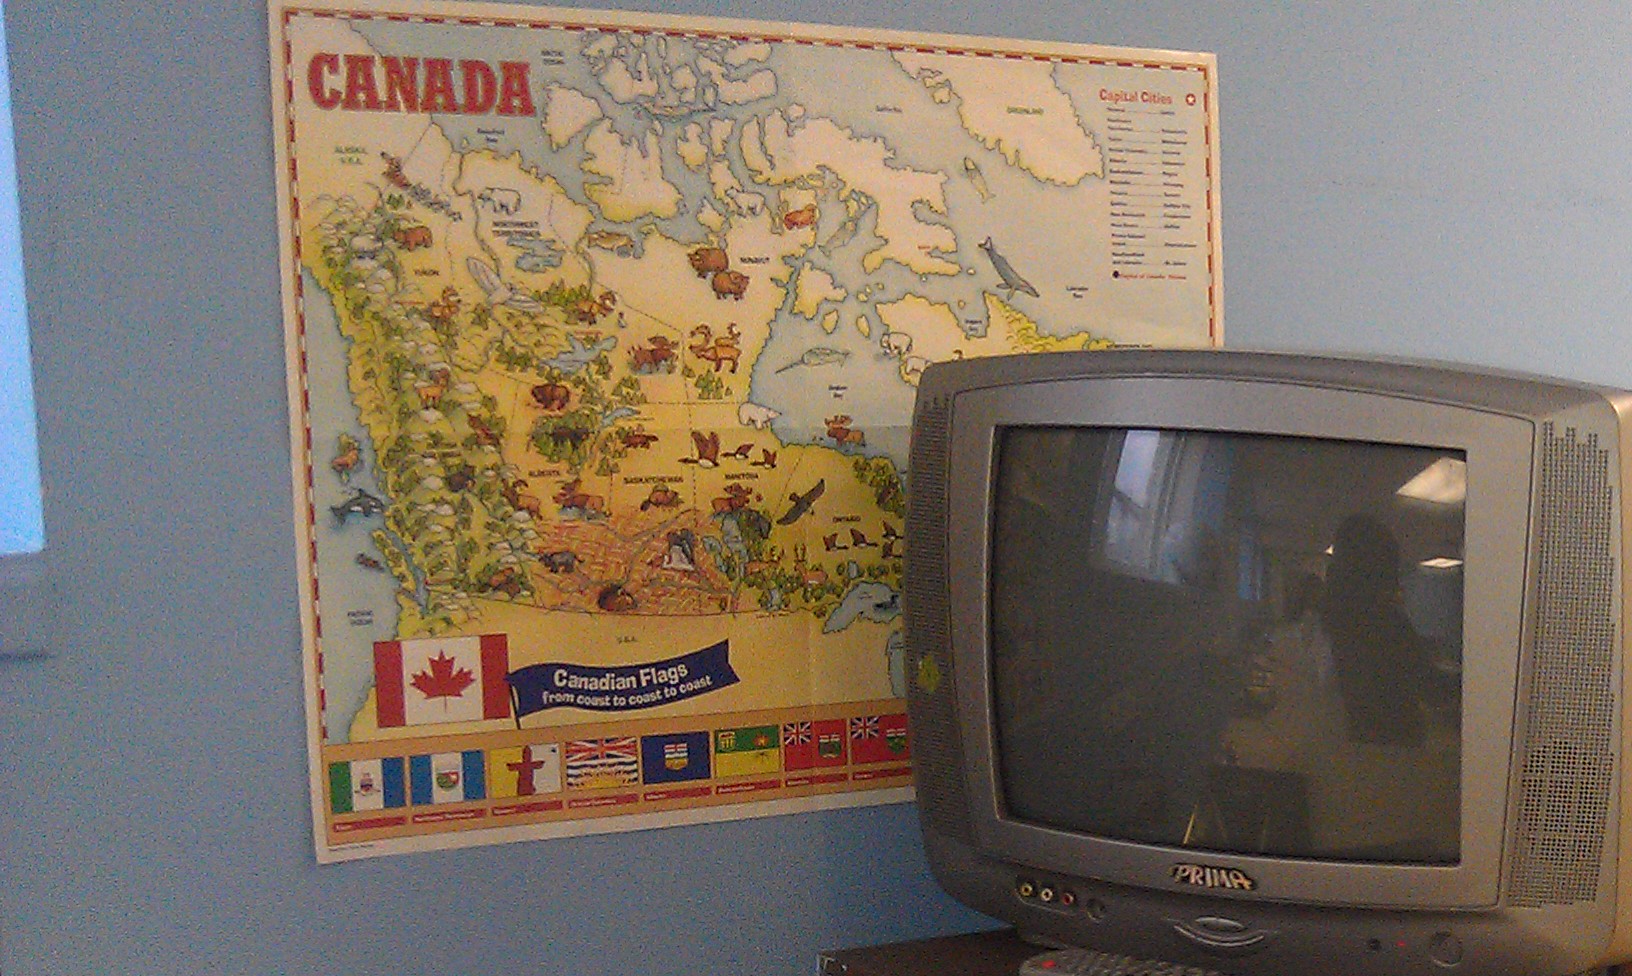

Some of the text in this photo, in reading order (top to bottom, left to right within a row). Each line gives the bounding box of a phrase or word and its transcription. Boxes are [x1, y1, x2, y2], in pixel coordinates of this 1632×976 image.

[307, 53, 536, 117] CANADA
[1099, 88, 1172, 104] Capital Cities
[541, 674, 714, 707] from coast to coast to coast
[553, 661, 689, 692] Canadian Flags
[1168, 863, 1254, 891] PRIMA
